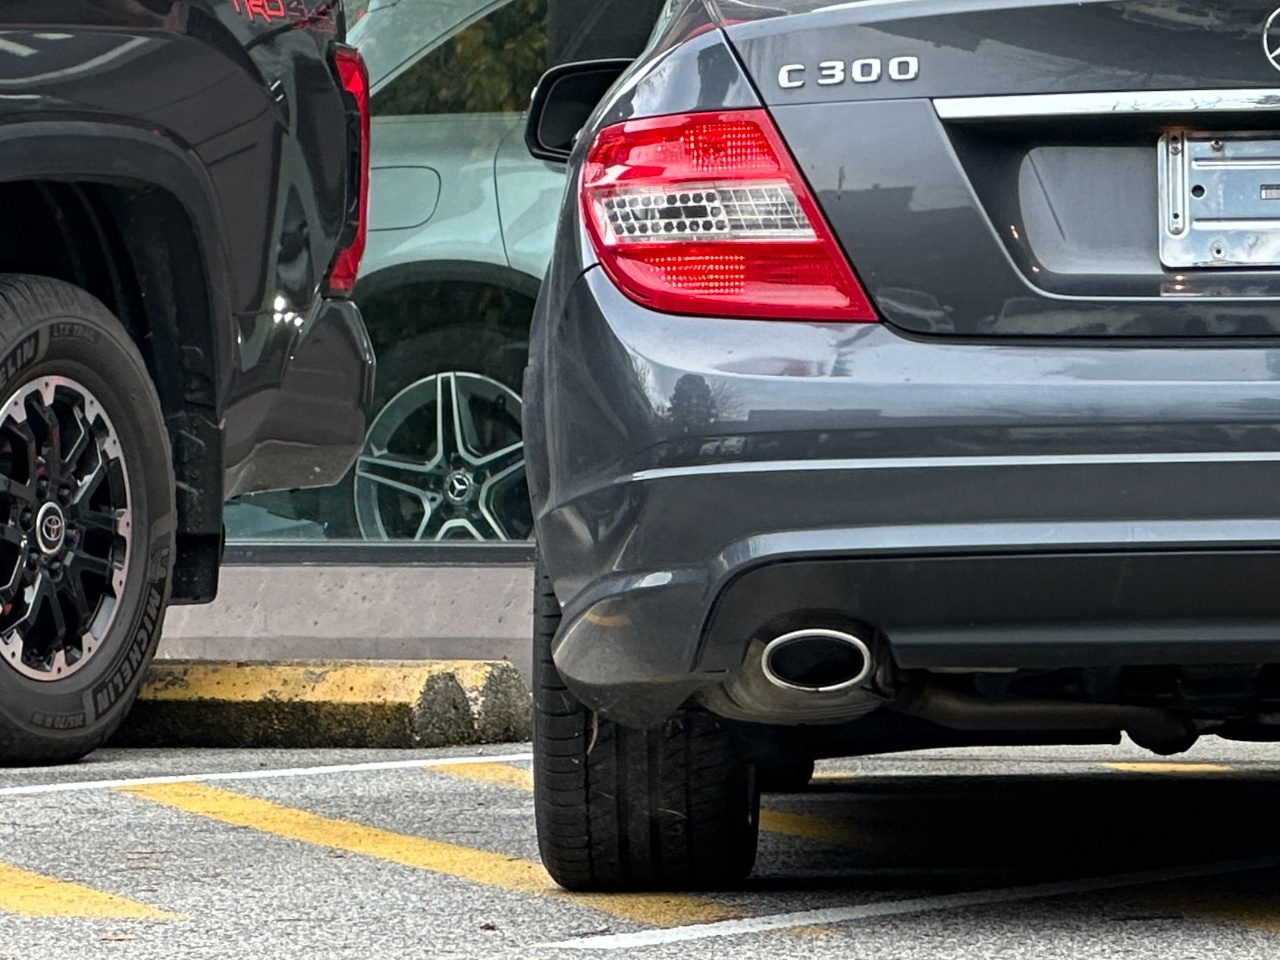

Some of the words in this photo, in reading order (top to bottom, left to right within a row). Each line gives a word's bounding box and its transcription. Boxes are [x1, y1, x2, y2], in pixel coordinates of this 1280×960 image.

[778, 64, 805, 88] C
[817, 56, 919, 85] 300
[96, 589, 161, 715] MICHELIN
